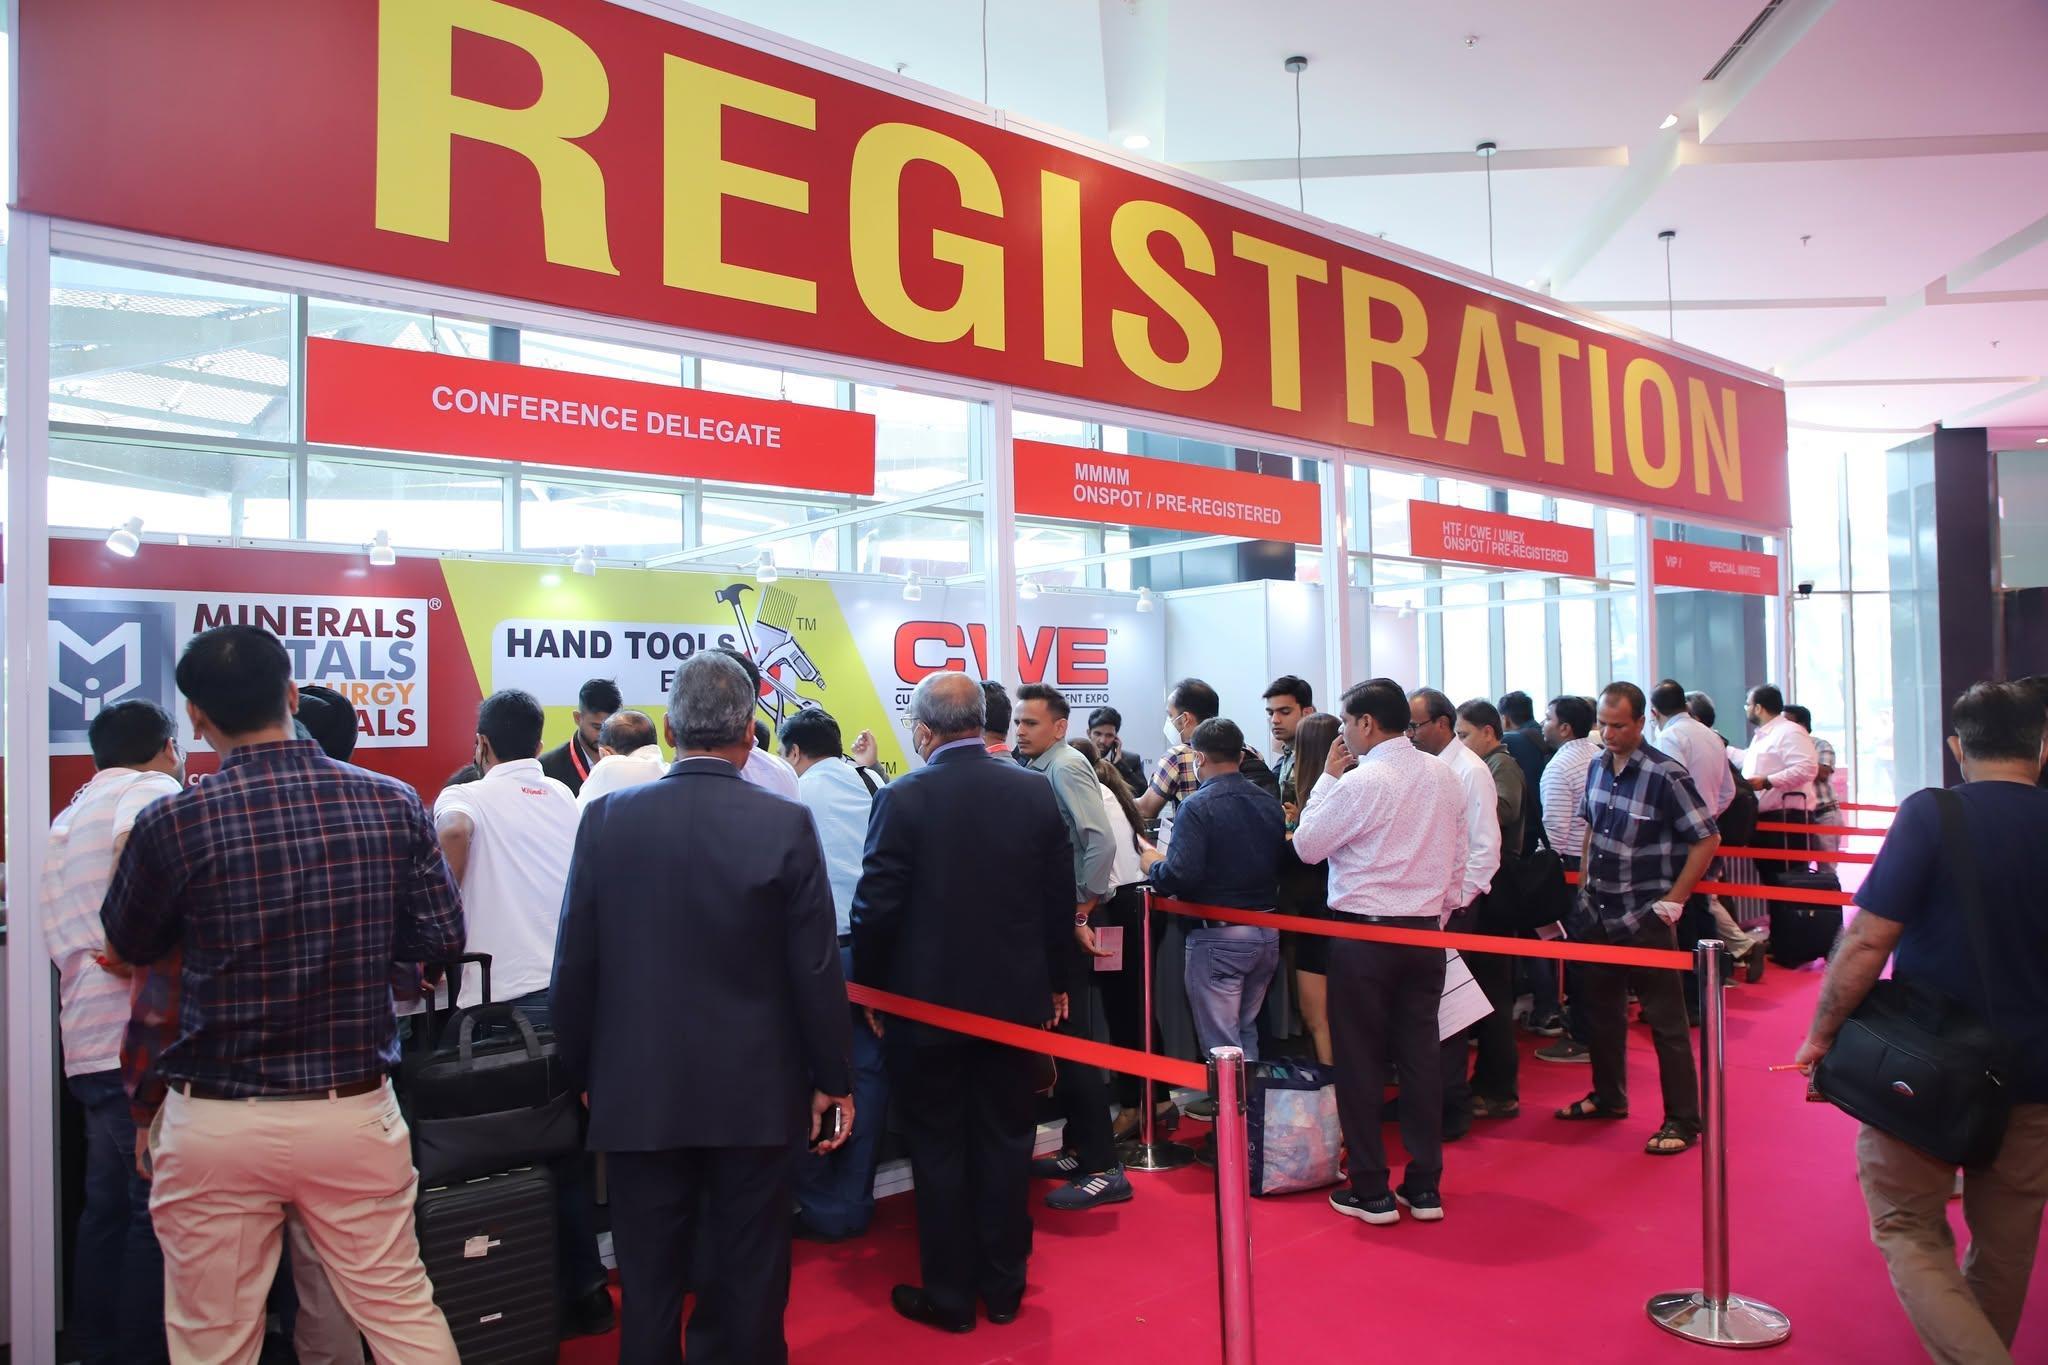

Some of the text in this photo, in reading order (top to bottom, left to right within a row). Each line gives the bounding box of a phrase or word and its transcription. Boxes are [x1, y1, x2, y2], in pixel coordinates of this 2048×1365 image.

[375, 0, 1743, 502] REGISTRATION
[432, 385, 782, 449] CONFERENCE DELEGATE
[1075, 463, 1130, 486] MMMM
[1073, 485, 1281, 525] ONSPOT / PRE-REGISTERED
[1442, 521, 1462, 536] HTF
[1469, 525, 1491, 540] CWE
[1499, 529, 1525, 544] UMEX
[1443, 536, 1485, 553] ONSPOT
[1492, 542, 1569, 563] PRE-REGISTERED
[1665, 555, 1678, 568] VIP
[1709, 560, 1737, 575] SPECIAL
[193, 603, 416, 639] MINERALS
[795, 617, 816, 631] TM
[507, 628, 612, 659] HAND
[894, 621, 1109, 686] CWE
[285, 639, 416, 681] TALS
[1085, 694, 1109, 704] EXPO
